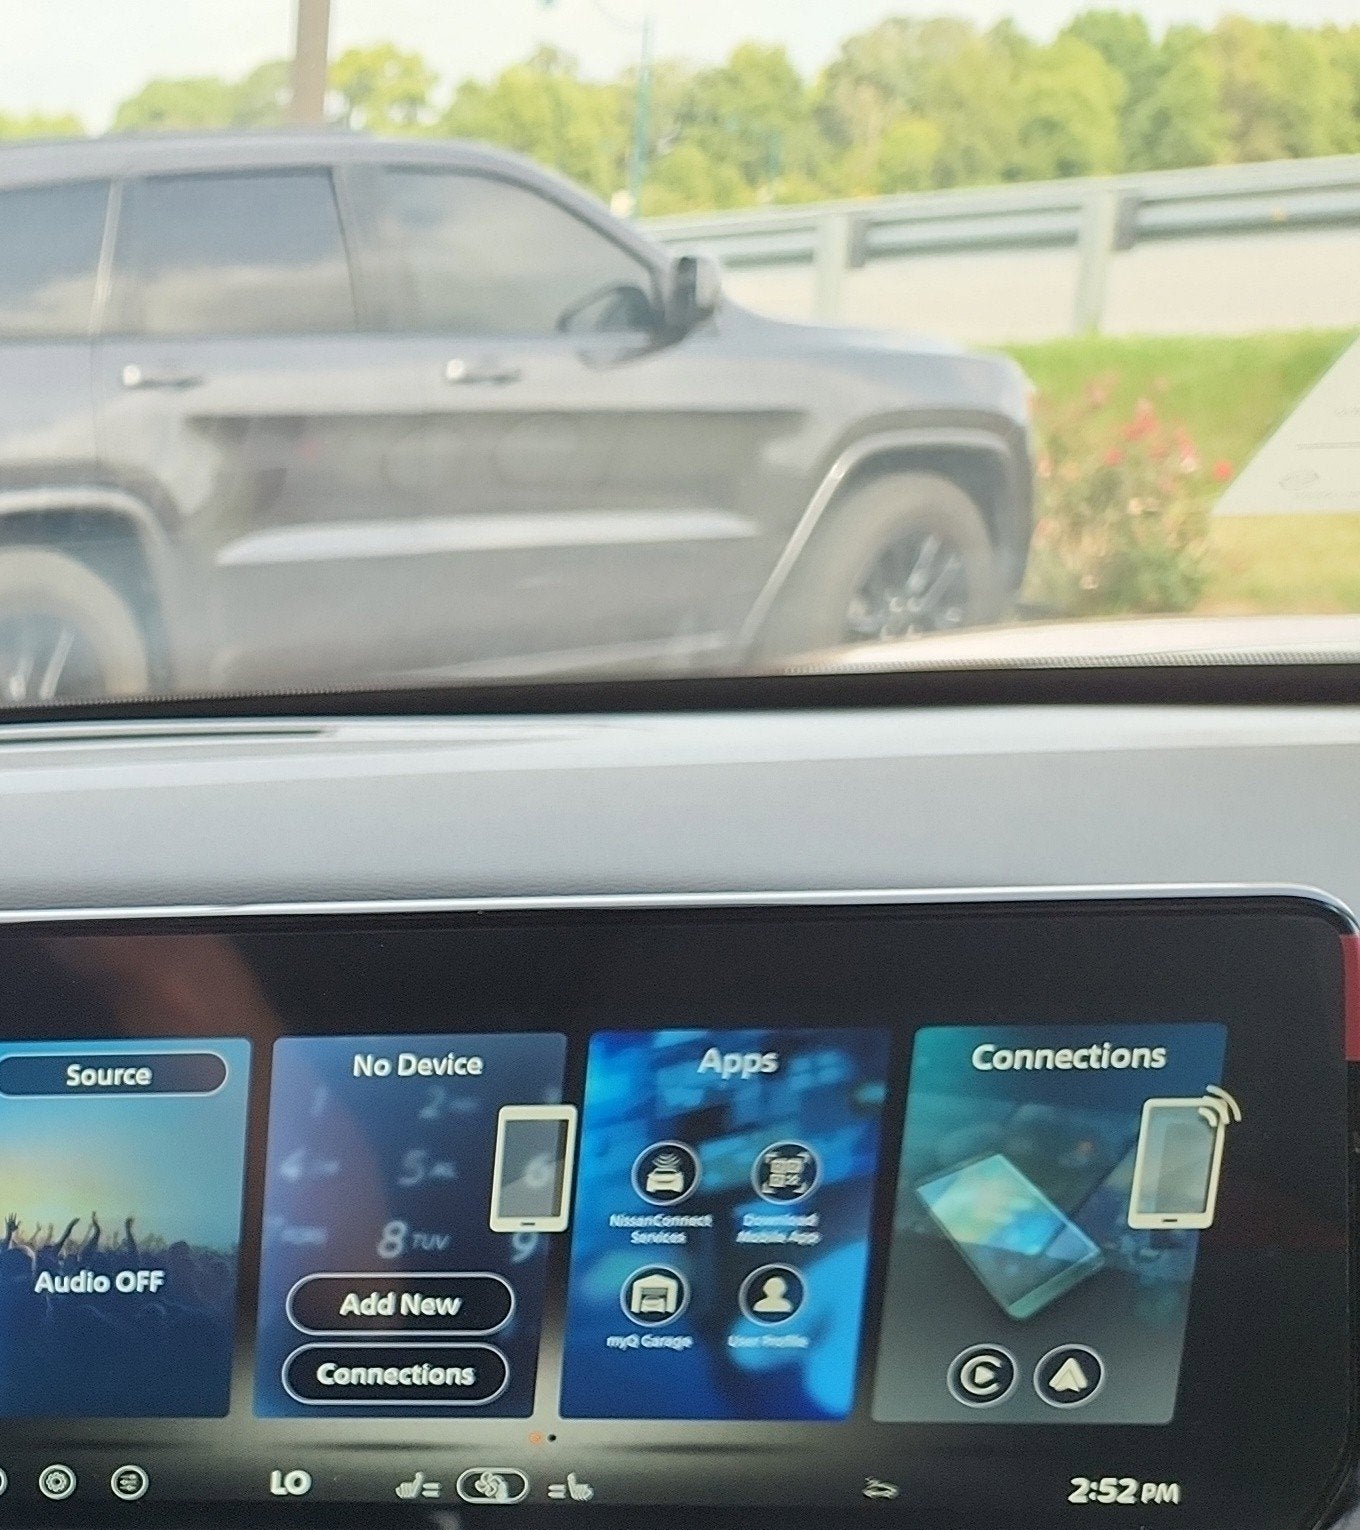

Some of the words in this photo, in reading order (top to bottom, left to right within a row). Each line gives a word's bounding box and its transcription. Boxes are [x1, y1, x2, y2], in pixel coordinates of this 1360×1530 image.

[352, 1053, 391, 1078] No
[398, 1051, 484, 1077] Device
[697, 1047, 779, 1079] Apps
[971, 1042, 1167, 1071] Connections
[66, 1064, 153, 1087] Source
[377, 1220, 408, 1259] 8
[35, 1270, 111, 1294] Audio
[115, 1269, 165, 1293] OFF
[339, 1292, 396, 1317] Add
[400, 1291, 462, 1317] New
[316, 1361, 475, 1387] Connections
[270, 1469, 312, 1495] LO
[1068, 1477, 1140, 1504] 2:52
[1140, 1482, 1180, 1504] PM
